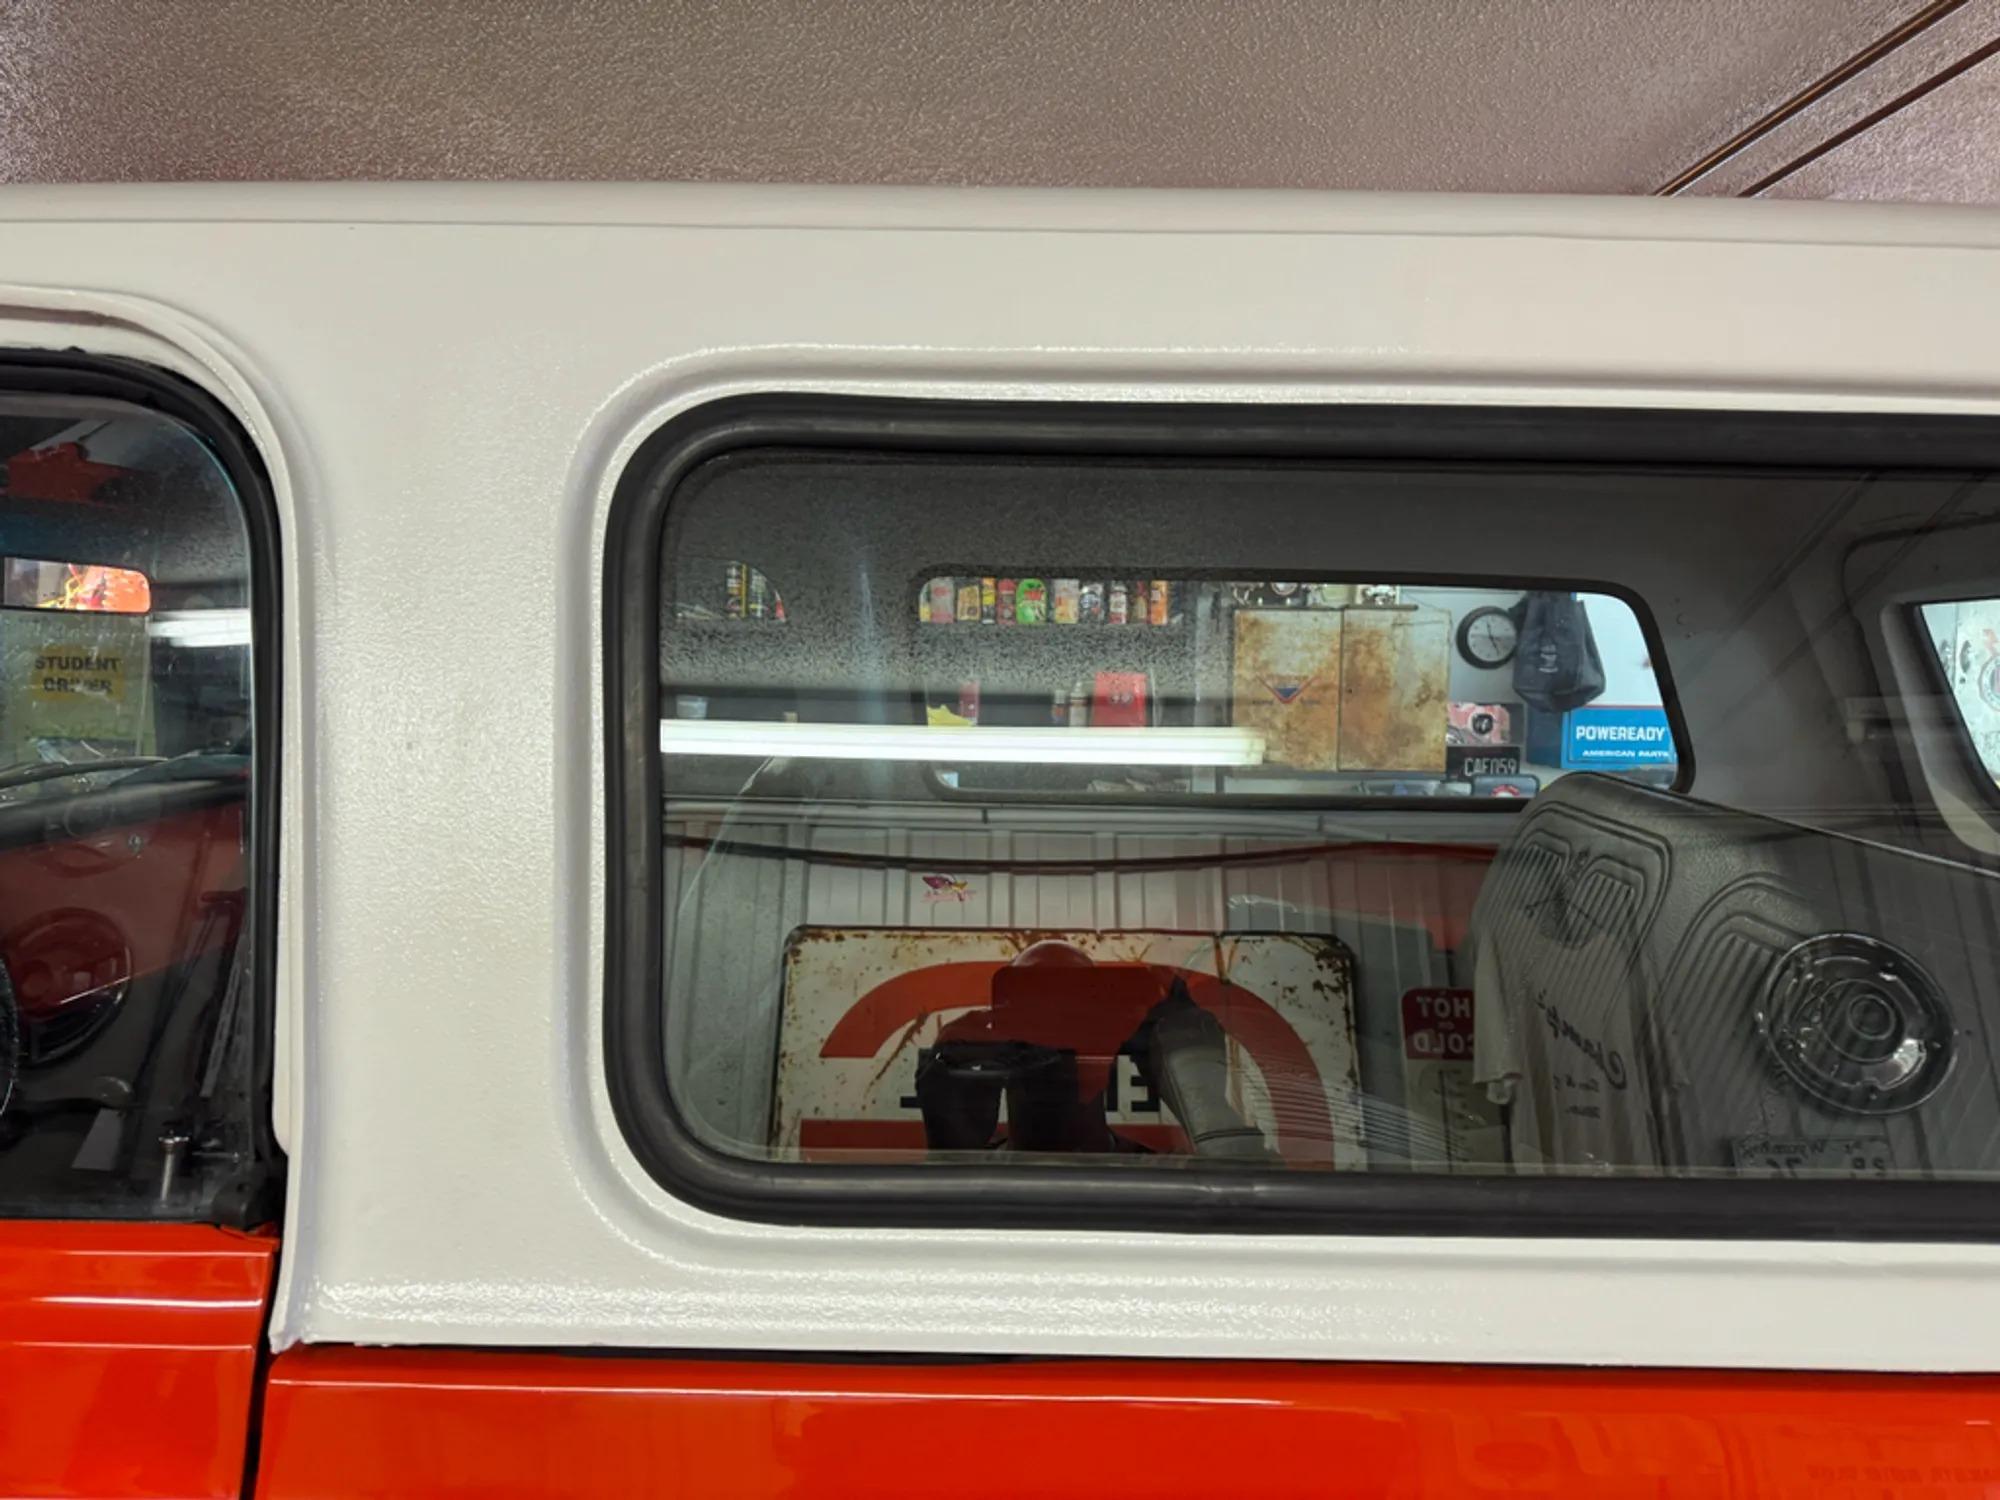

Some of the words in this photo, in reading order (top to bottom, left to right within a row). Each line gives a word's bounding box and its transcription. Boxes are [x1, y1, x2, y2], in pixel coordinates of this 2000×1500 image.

[35, 656, 121, 671] STUDENT
[1576, 726, 1665, 741] POWEREADY
[1582, 749, 1636, 758] AMERICAN
